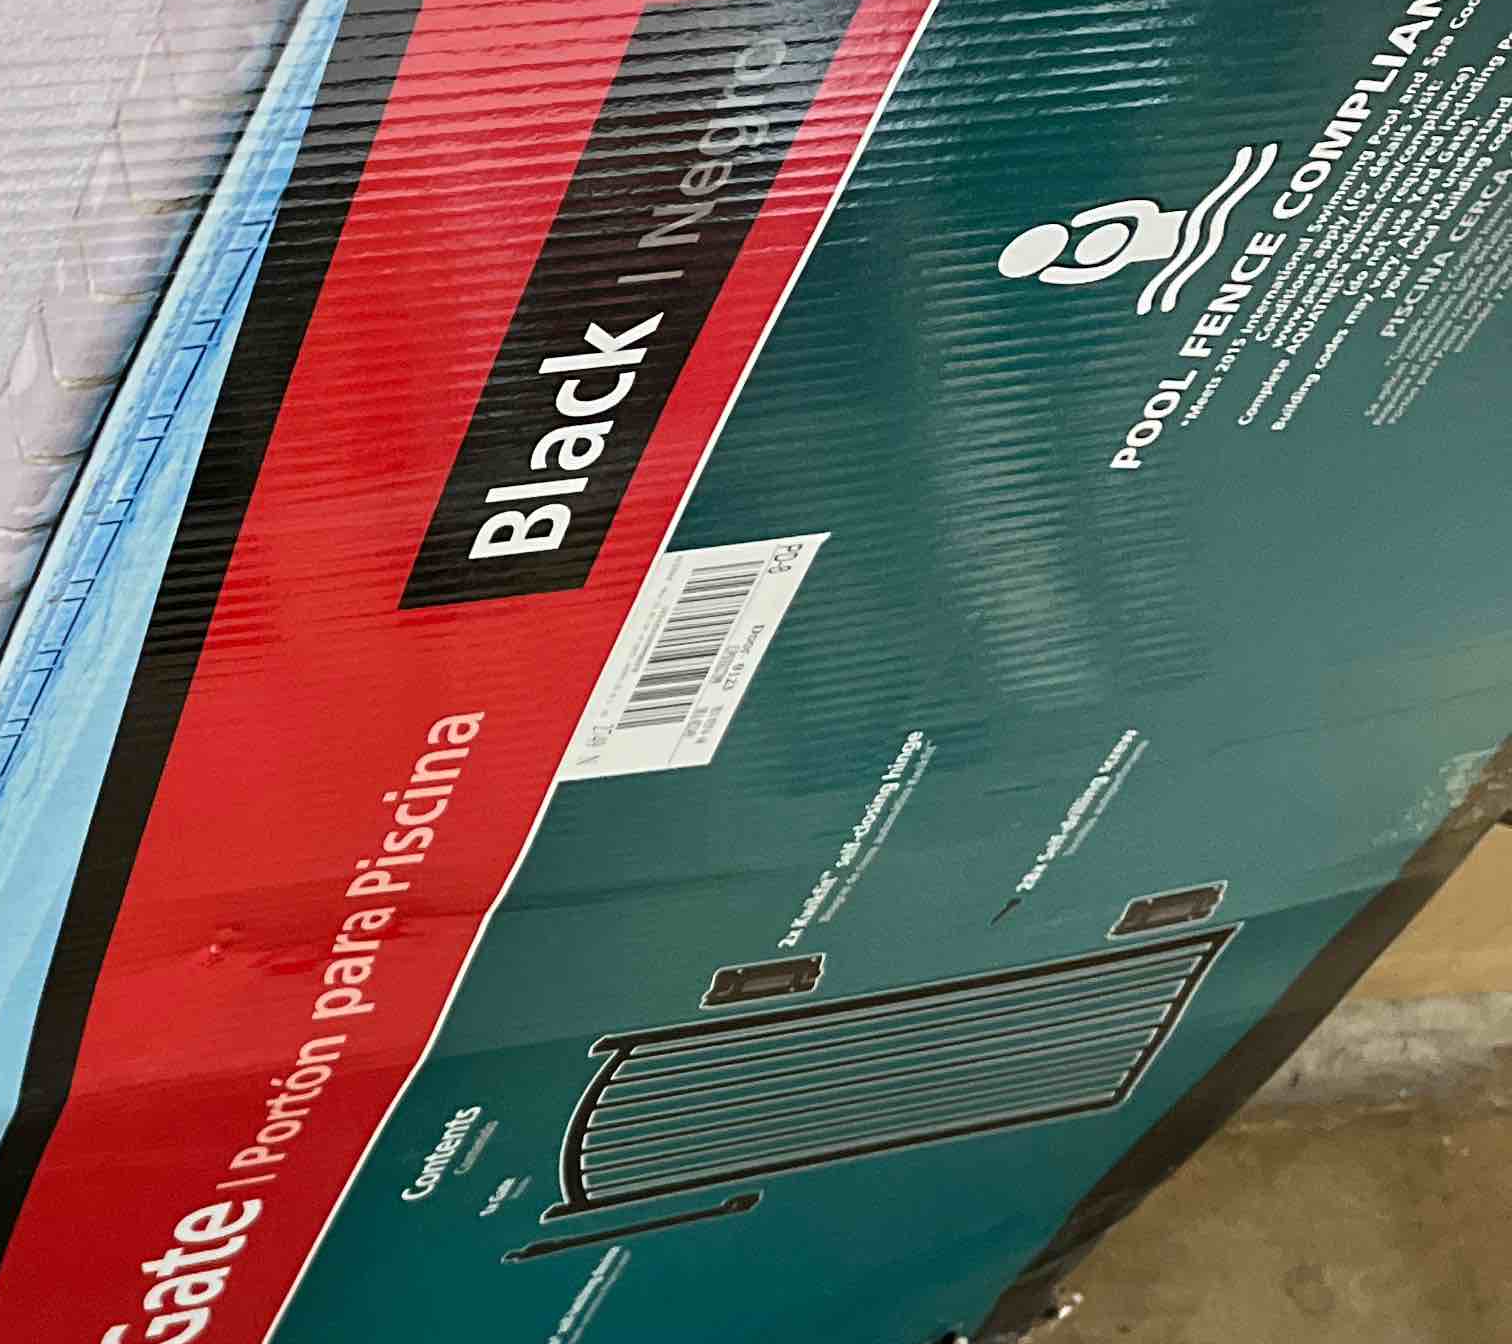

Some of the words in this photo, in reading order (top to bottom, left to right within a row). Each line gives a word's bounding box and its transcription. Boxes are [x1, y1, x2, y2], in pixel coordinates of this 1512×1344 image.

[1215, 338, 1247, 372] 2015
[1240, 237, 1314, 334] International
[1306, 150, 1376, 233] Swimming
[1368, 109, 1403, 145] Pool
[1399, 72, 1429, 104] and
[1423, 35, 1455, 67] Spa
[1238, 359, 1290, 425] Complete
[1351, 207, 1395, 260] system
[1392, 135, 1445, 203] required
[1255, 263, 1316, 342] Conditions
[1313, 216, 1351, 258] apply
[1343, 182, 1371, 211] (for
[1369, 124, 1413, 178] details
[1409, 80, 1444, 119] visit:
[1272, 373, 1321, 431] Building
[1315, 328, 1349, 370] codes
[1345, 292, 1375, 325] may
[1398, 192, 1445, 249] Always
[1441, 97, 1512, 187] understand
[1343, 269, 1369, 296] (do
[1366, 240, 1392, 267] not
[1388, 209, 1413, 236] use
[1407, 167, 1443, 204] Yard
[1380, 251, 1455, 338] PISCINA
[1449, 169, 1512, 242] CERCA
[1381, 264, 1412, 299] your
[1406, 224, 1441, 260] local
[1434, 156, 1493, 221] building
[468, 311, 664, 560] Black
[637, 38, 786, 251] Negro
[1110, 369, 1197, 470] POOL
[1179, 232, 1289, 358] FENCE
[346, 710, 485, 896] Piscina
[881, 730, 924, 782] hinge
[312, 905, 395, 1025] para
[230, 1031, 348, 1184] Portón
[401, 1106, 482, 1201] Contents
